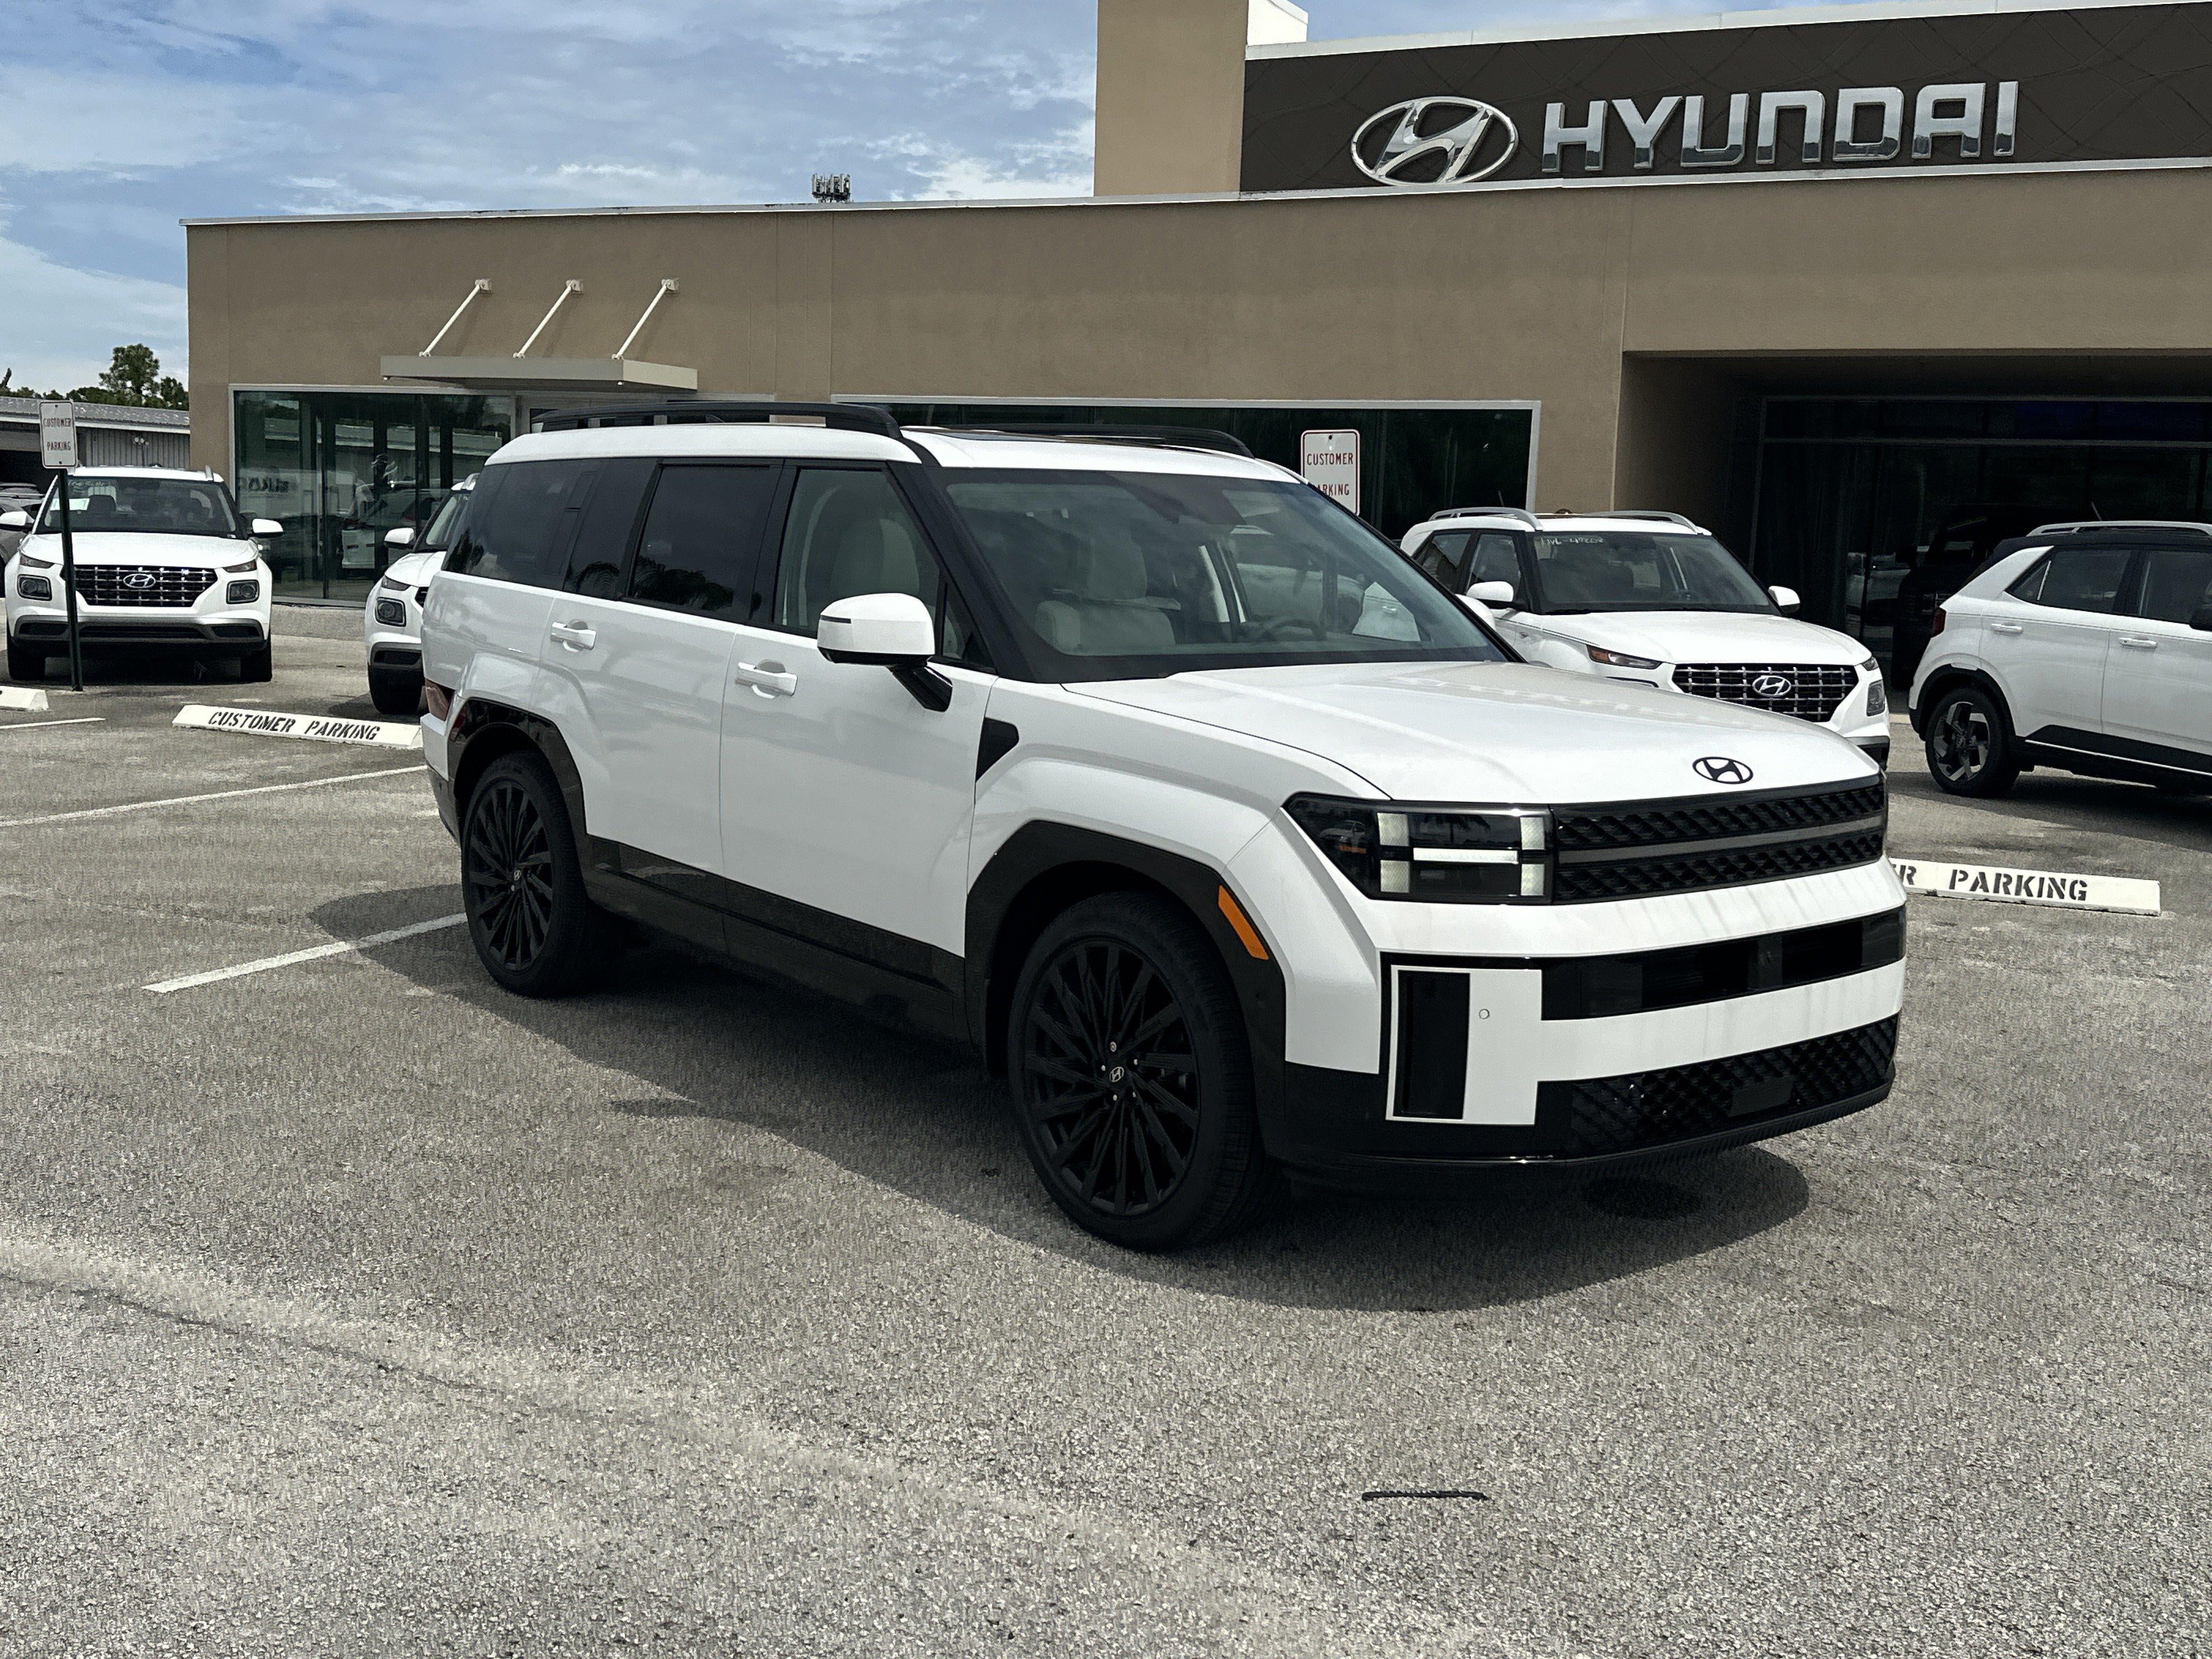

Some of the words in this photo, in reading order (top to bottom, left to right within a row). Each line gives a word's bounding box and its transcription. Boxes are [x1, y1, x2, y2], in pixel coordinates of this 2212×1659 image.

[1542, 81, 2019, 173] HYUNDAI
[43, 417, 71, 427] CUSTOMER
[46, 441, 71, 452] PARKING
[1306, 452, 1353, 466] CUSTOMER
[1317, 483, 1350, 496] RKING
[208, 712, 296, 733] CUSTOMER
[304, 720, 381, 741] PARKING
[1949, 868, 2088, 901] PARKING
